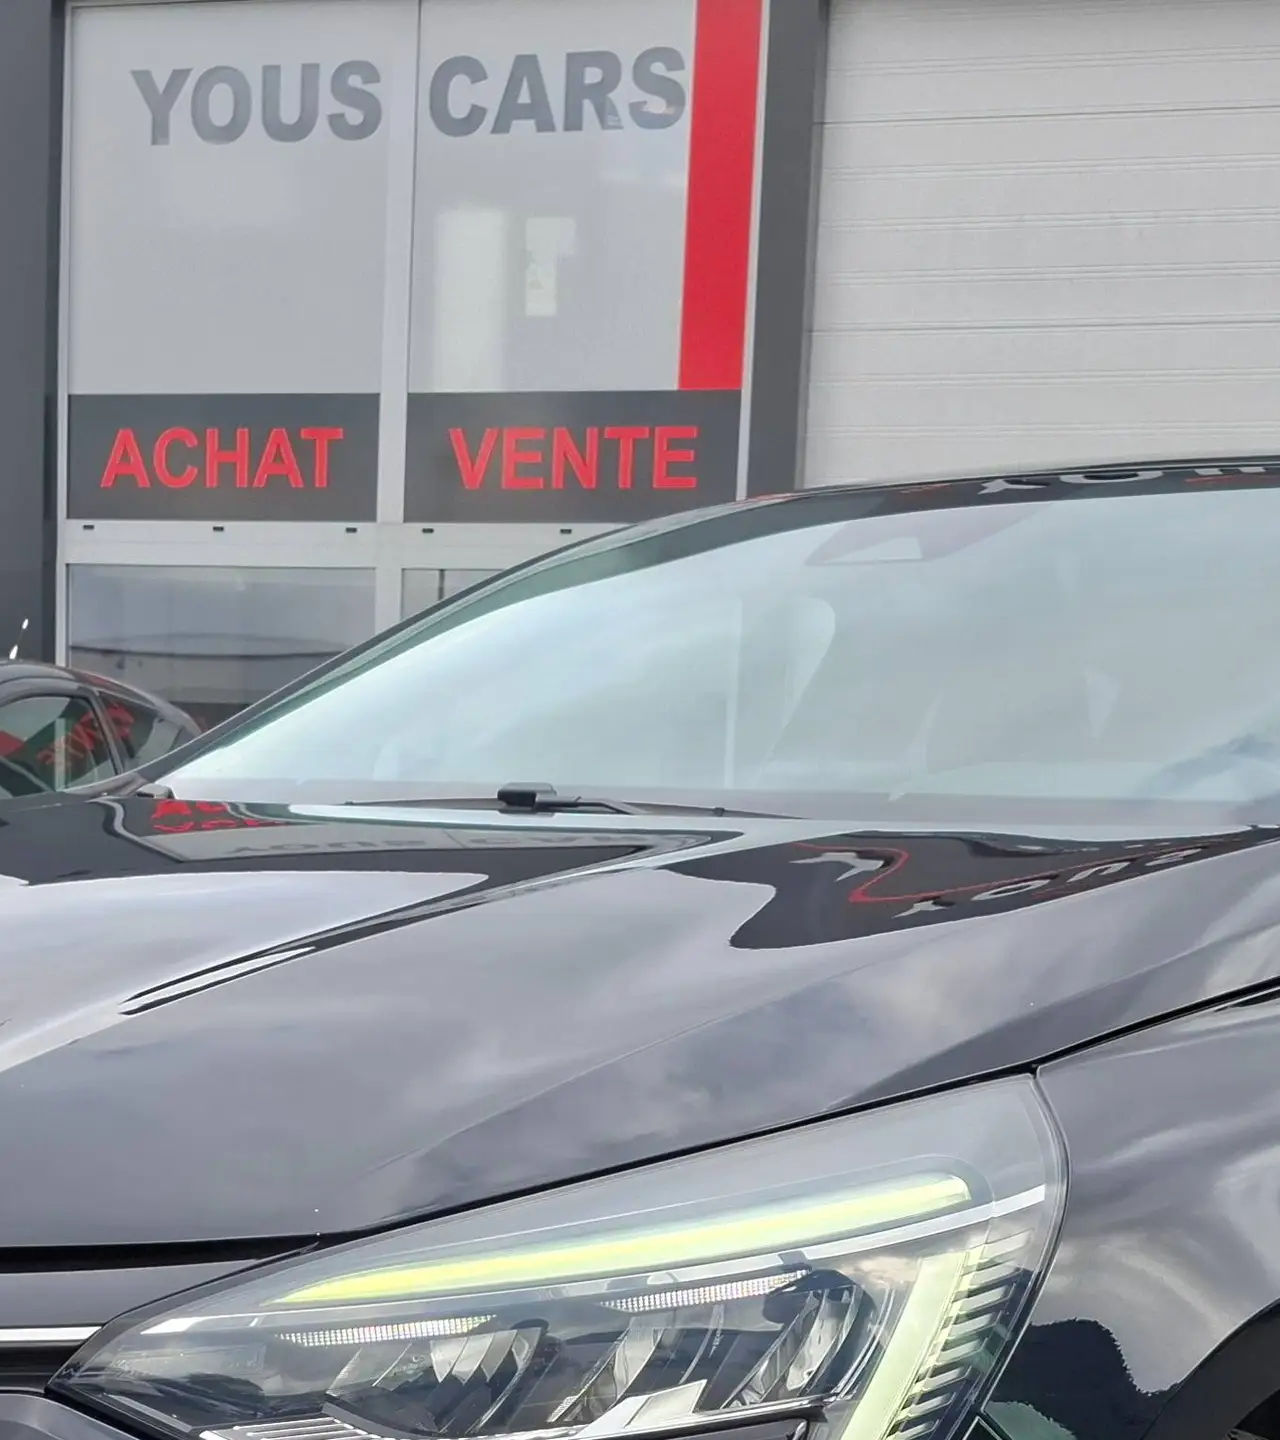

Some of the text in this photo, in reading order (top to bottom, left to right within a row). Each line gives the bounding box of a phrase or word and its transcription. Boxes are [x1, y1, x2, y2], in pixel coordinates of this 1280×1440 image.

[131, 47, 687, 146] YOUS CARS
[100, 427, 344, 488] ACHAT
[448, 425, 698, 489] VENTE
